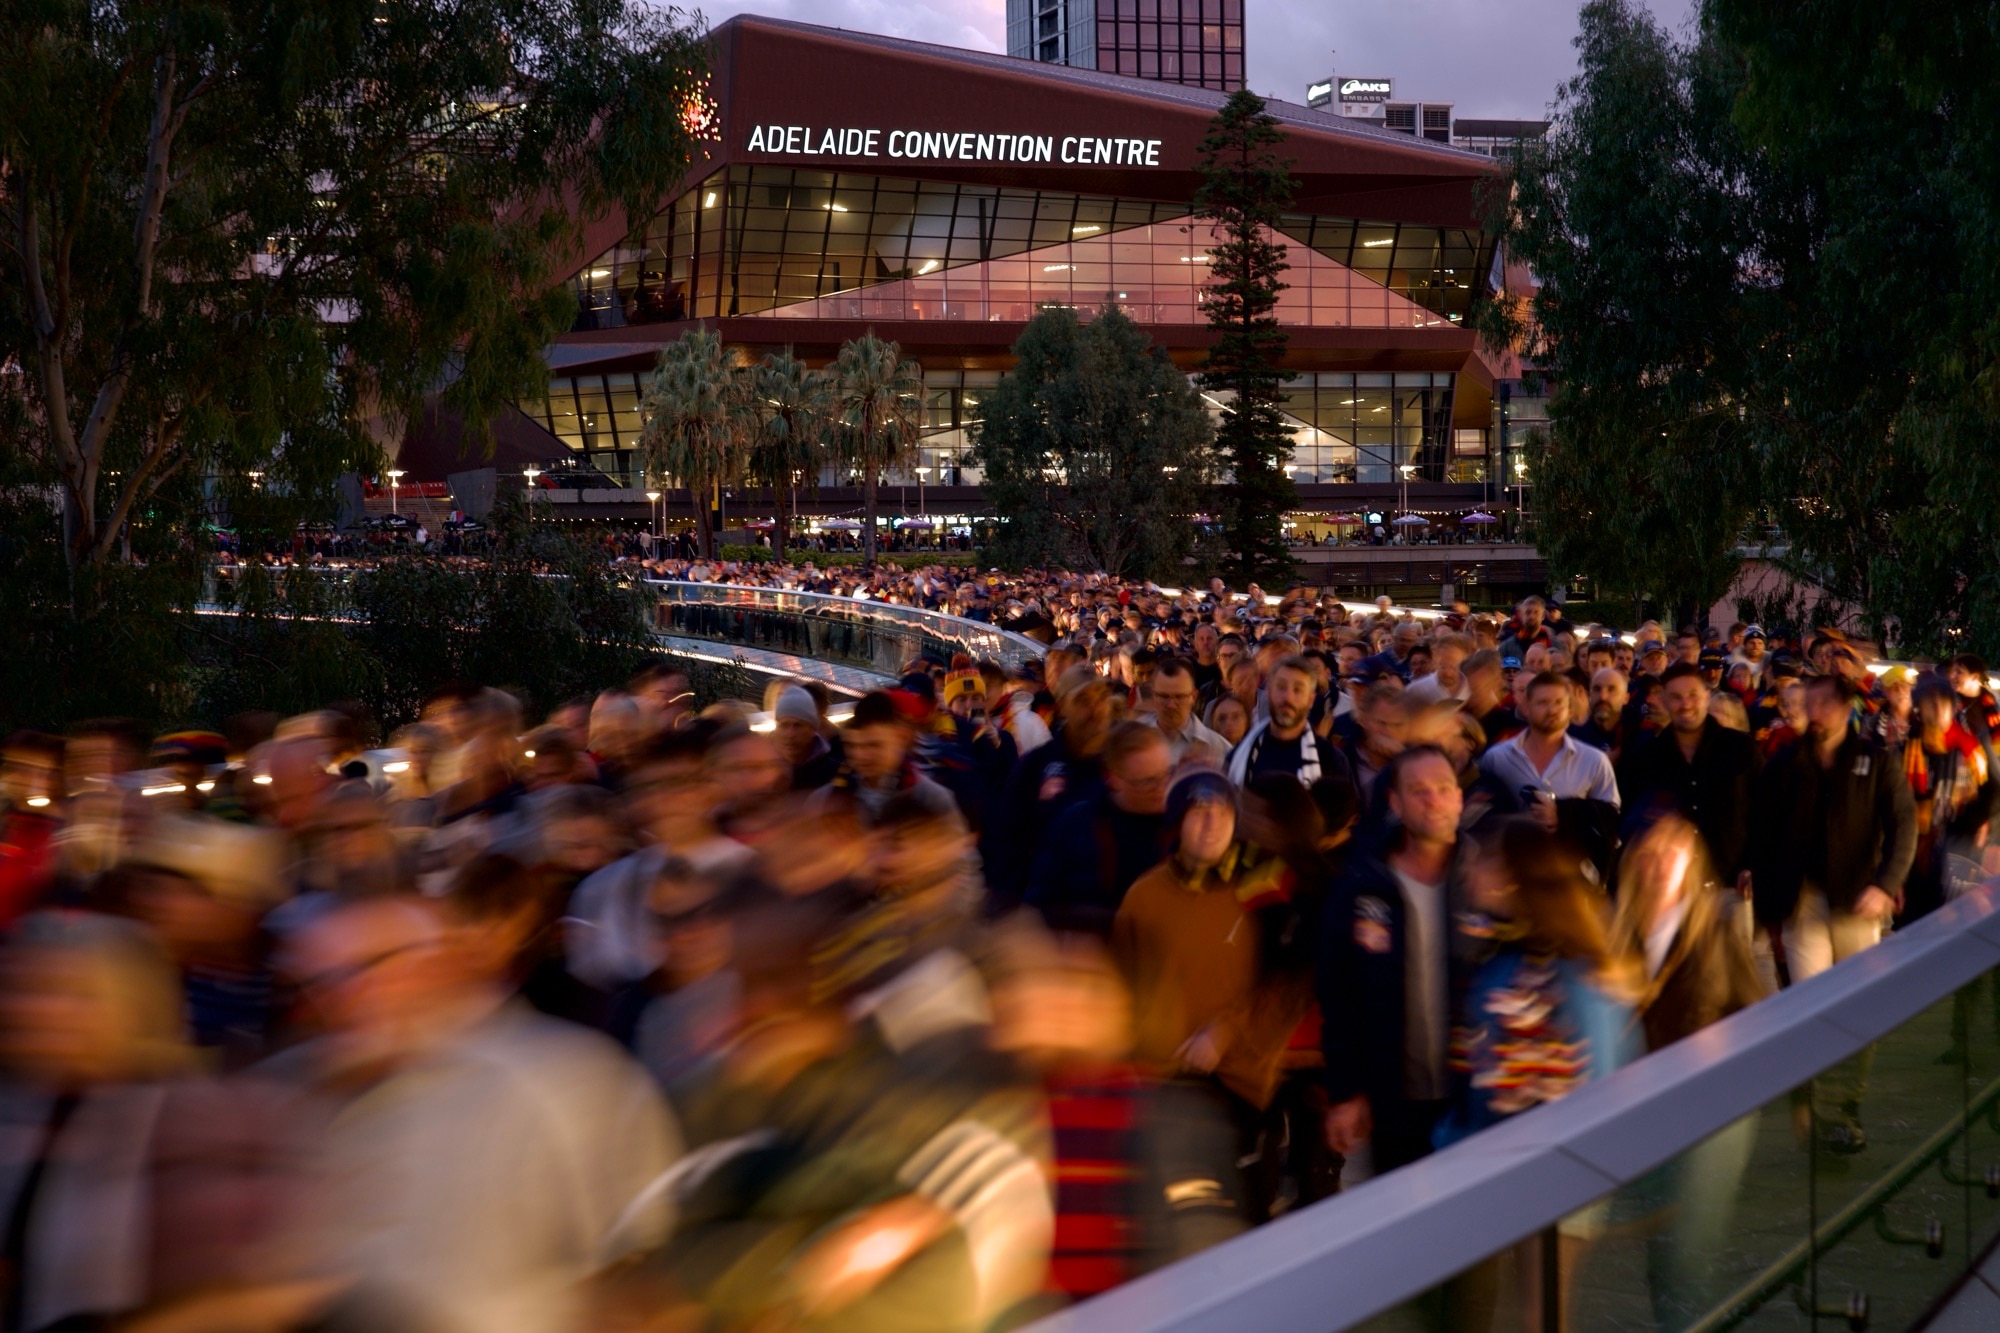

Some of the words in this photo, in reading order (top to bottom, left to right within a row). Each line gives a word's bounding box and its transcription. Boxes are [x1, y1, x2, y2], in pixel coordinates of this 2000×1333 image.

[1341, 79, 1390, 95] OAKS
[748, 125, 881, 156] ADELAIDE
[888, 131, 1053, 162] CONVENTION
[1060, 137, 1162, 166] CENTRE
